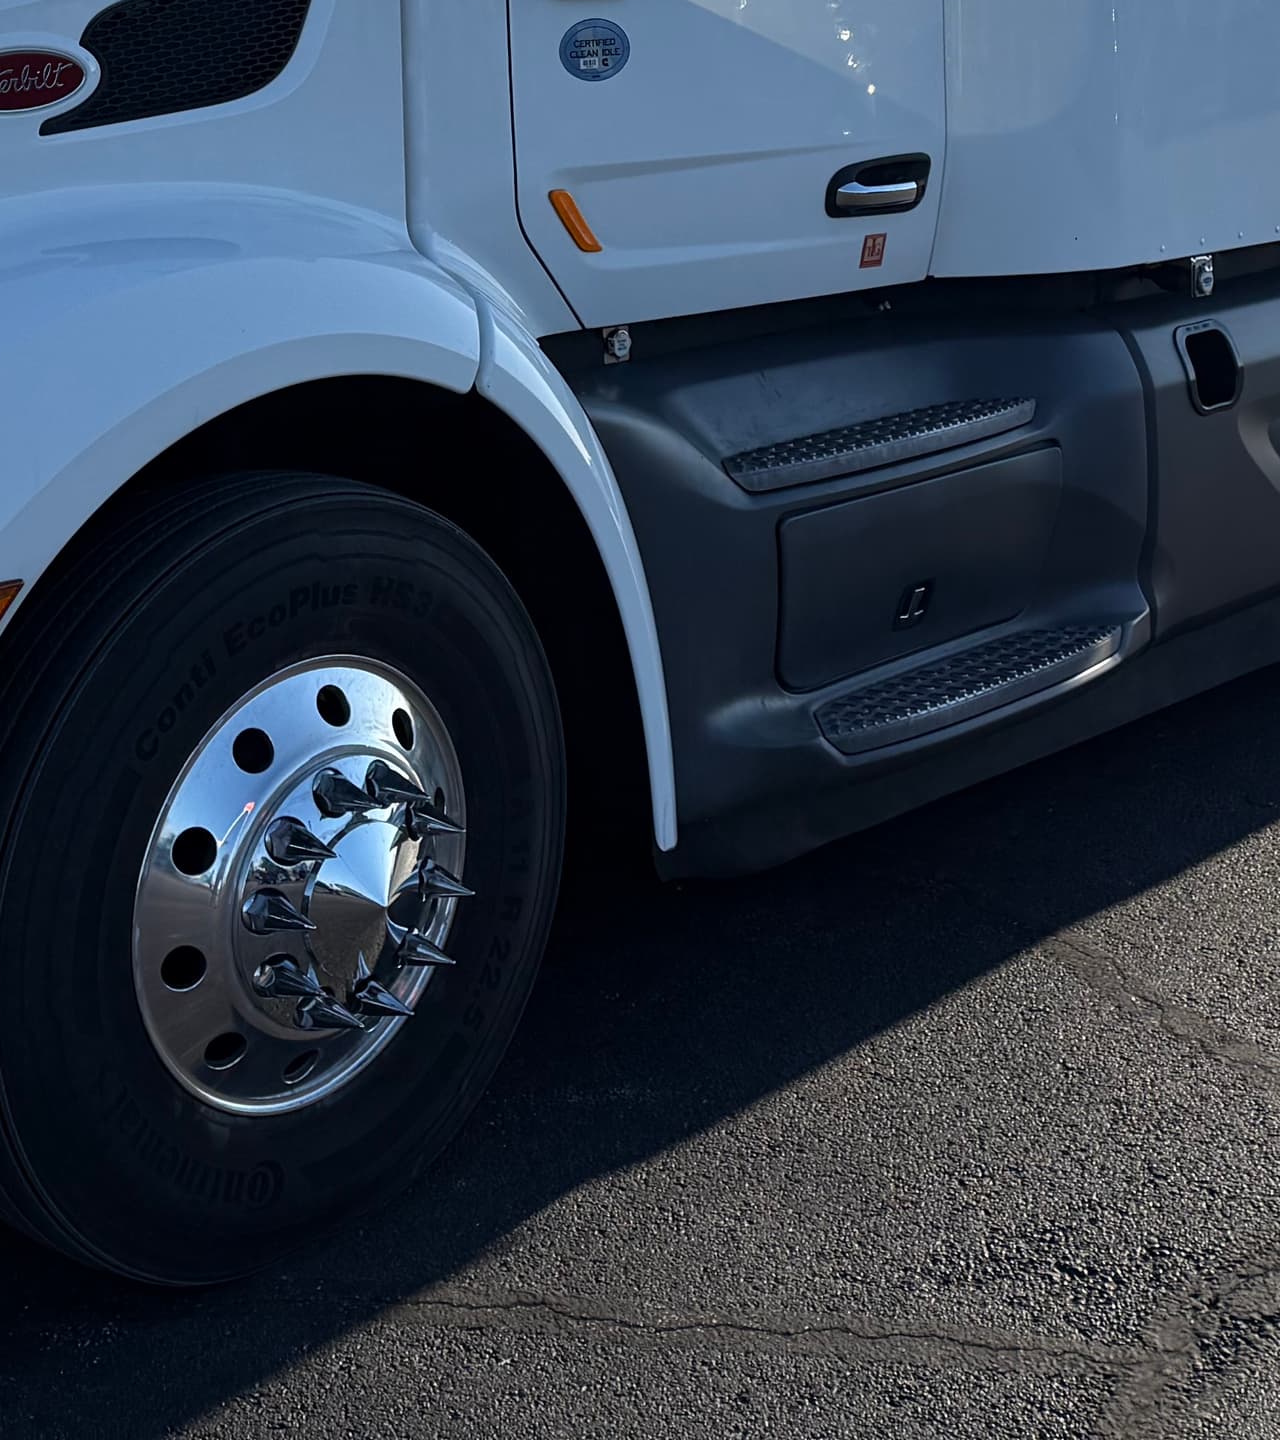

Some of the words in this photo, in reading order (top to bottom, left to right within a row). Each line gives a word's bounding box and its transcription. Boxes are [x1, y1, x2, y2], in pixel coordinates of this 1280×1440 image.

[573, 38, 616, 48] CERTIFIED
[569, 48, 598, 58] CLEAN
[602, 47, 621, 56] IDLE
[135, 647, 217, 762] Conti
[222, 579, 358, 657] EcoPlus
